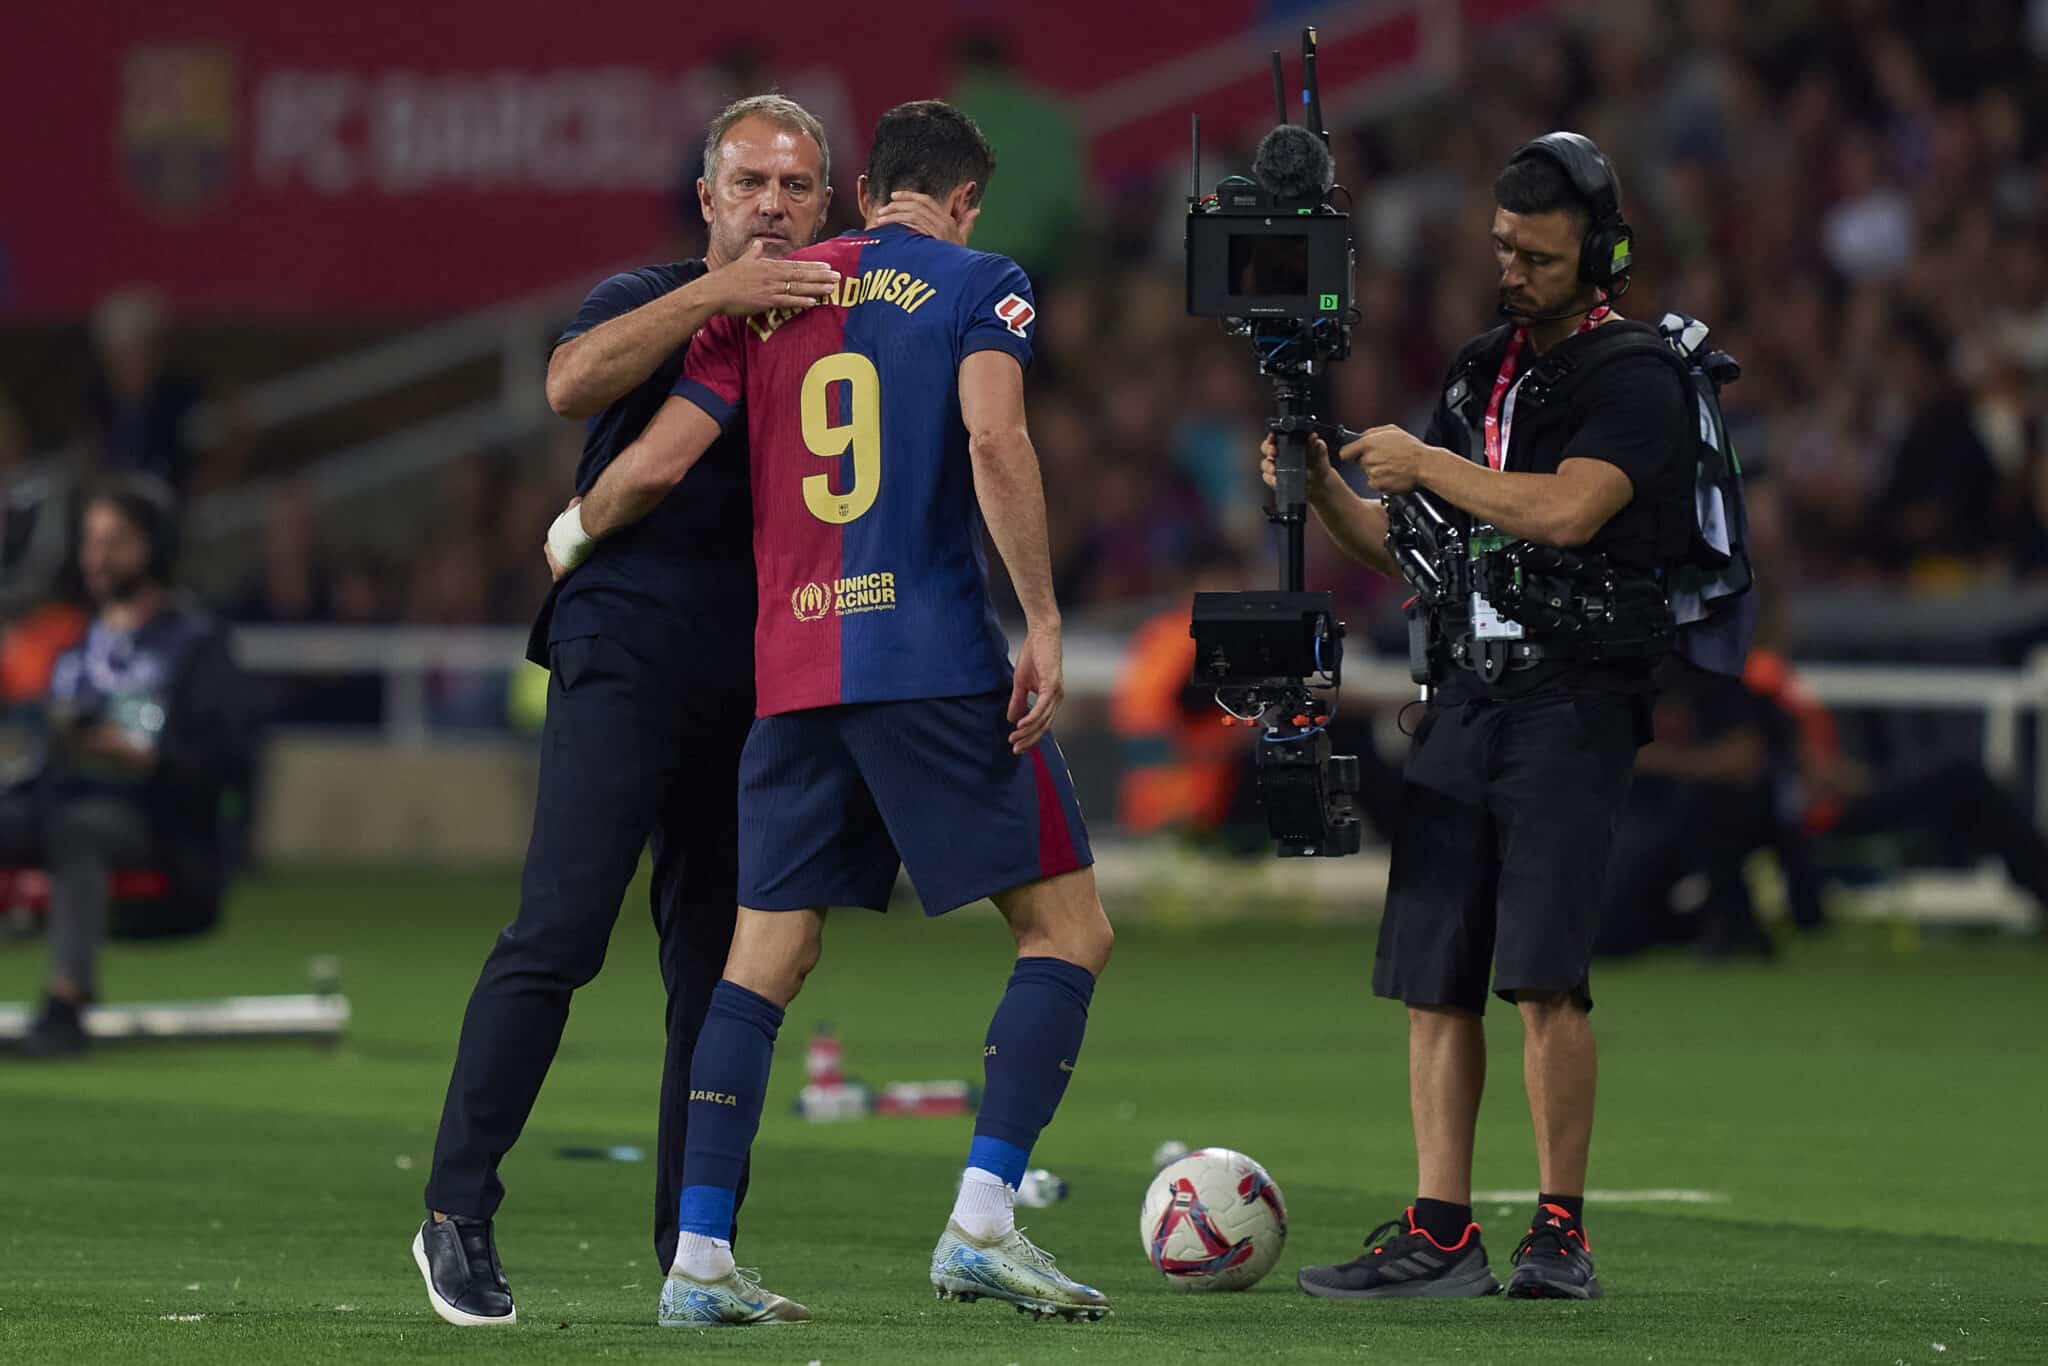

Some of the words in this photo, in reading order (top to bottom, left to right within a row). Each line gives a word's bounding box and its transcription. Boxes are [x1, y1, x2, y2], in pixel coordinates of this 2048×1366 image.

[800, 352, 881, 523] 9
[834, 572, 895, 595] UNHCR
[835, 587, 896, 609] ACNUR
